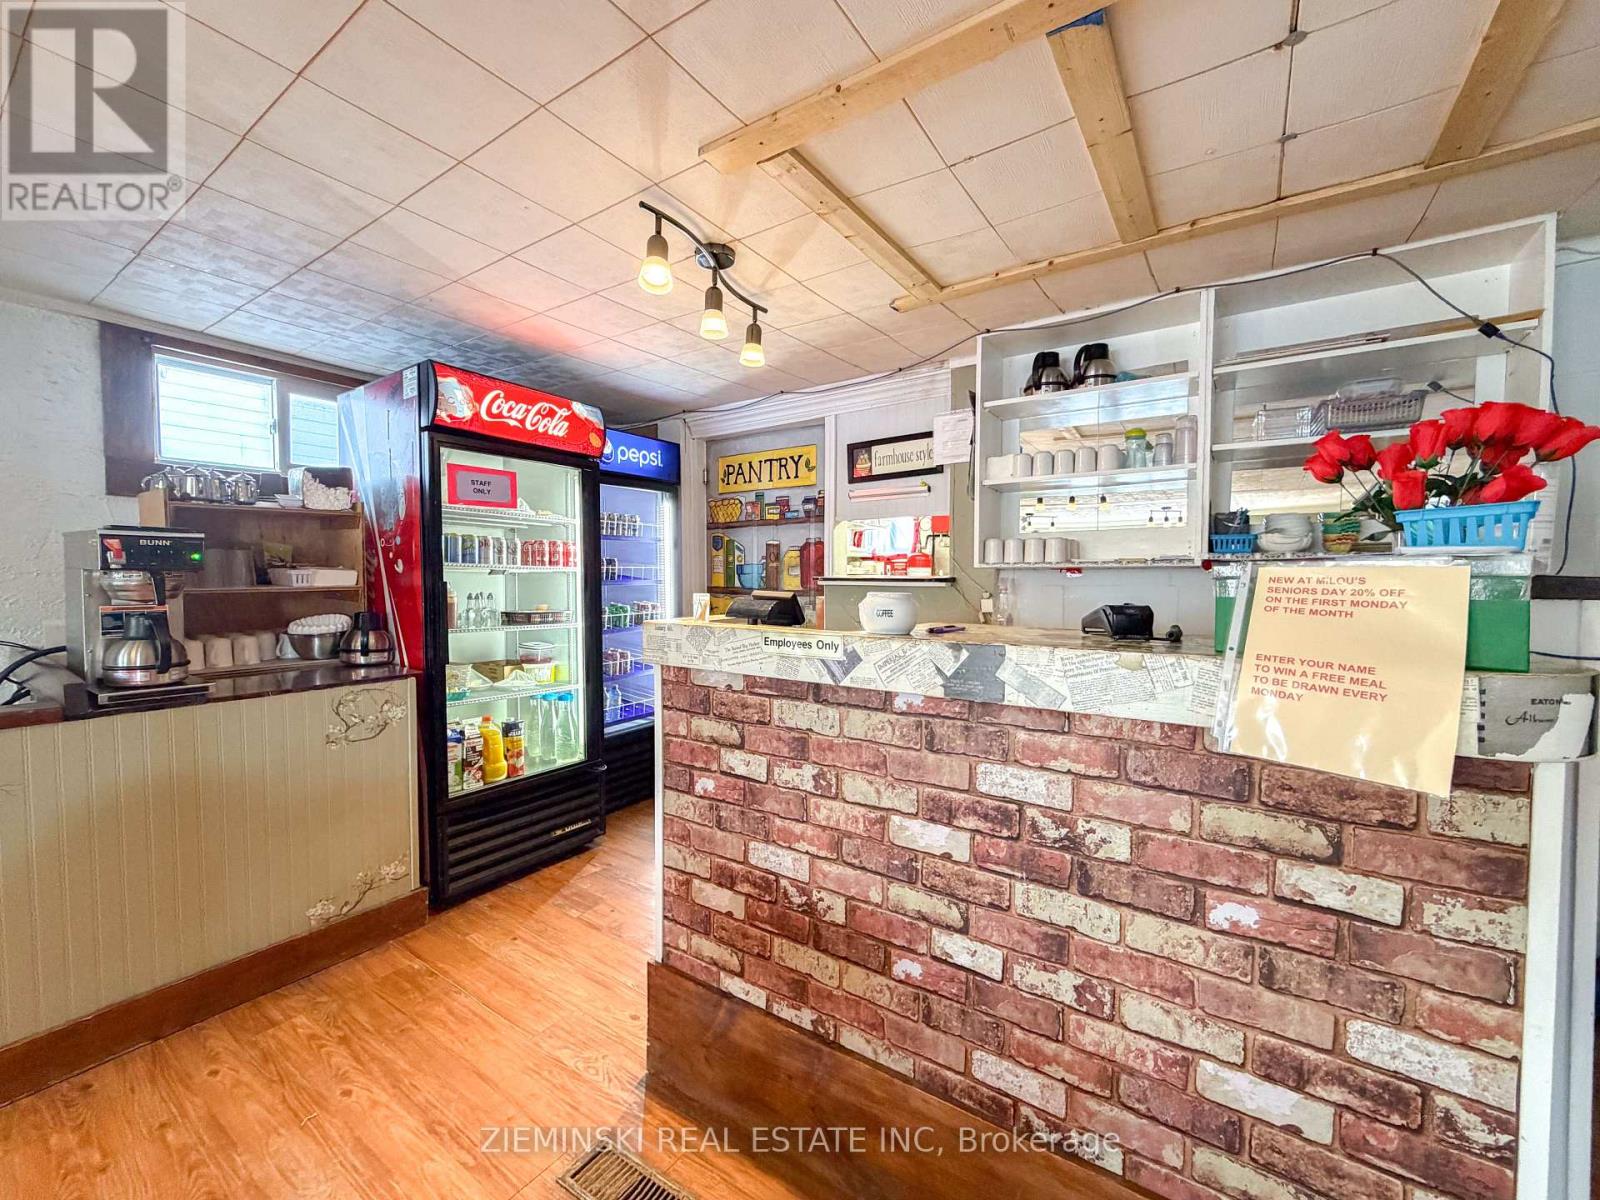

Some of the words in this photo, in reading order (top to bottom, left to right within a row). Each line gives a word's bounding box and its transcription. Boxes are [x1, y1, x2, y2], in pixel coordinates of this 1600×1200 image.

[479, 389, 571, 437] Coca-Cola
[617, 445, 663, 468] pepsi
[874, 448, 914, 468] farmhouse
[916, 442, 934, 466] style
[725, 455, 804, 486] PANTRY
[470, 479, 491, 487] STAFF
[472, 487, 491, 495] ONLY
[1268, 576, 1294, 585] NEW
[1297, 576, 1313, 585] AT
[1267, 586, 1318, 596] SENIORS
[1321, 587, 1347, 597] DAY
[1350, 588, 1376, 598] 20%
[1379, 588, 1406, 598] OFF
[1265, 596, 1282, 604] ON
[1285, 596, 1309, 605] THE
[1311, 598, 1347, 607] FIRST
[1350, 600, 1408, 609] MONDAY
[875, 609, 893, 618] COFFEE
[1263, 605, 1280, 613] OF
[1282, 606, 1306, 615] THE
[1308, 608, 1354, 618] MONTH
[764, 637, 812, 649] Employees
[816, 639, 839, 653] Only
[1255, 653, 1296, 665] ENTER
[1299, 658, 1334, 670] YOUR
[1337, 663, 1377, 675] NAME
[1254, 663, 1270, 673] TO
[1273, 666, 1296, 677] WIN
[1299, 670, 1309, 678] A
[1311, 671, 1349, 683] FREE
[1349, 676, 1388, 689] MEAL
[1250, 686, 1304, 702] MONDAY
[1253, 675, 1269, 685] TO
[1271, 678, 1289, 688] BE
[1291, 680, 1339, 695] DRAWN
[1342, 688, 1388, 702] EVERY
